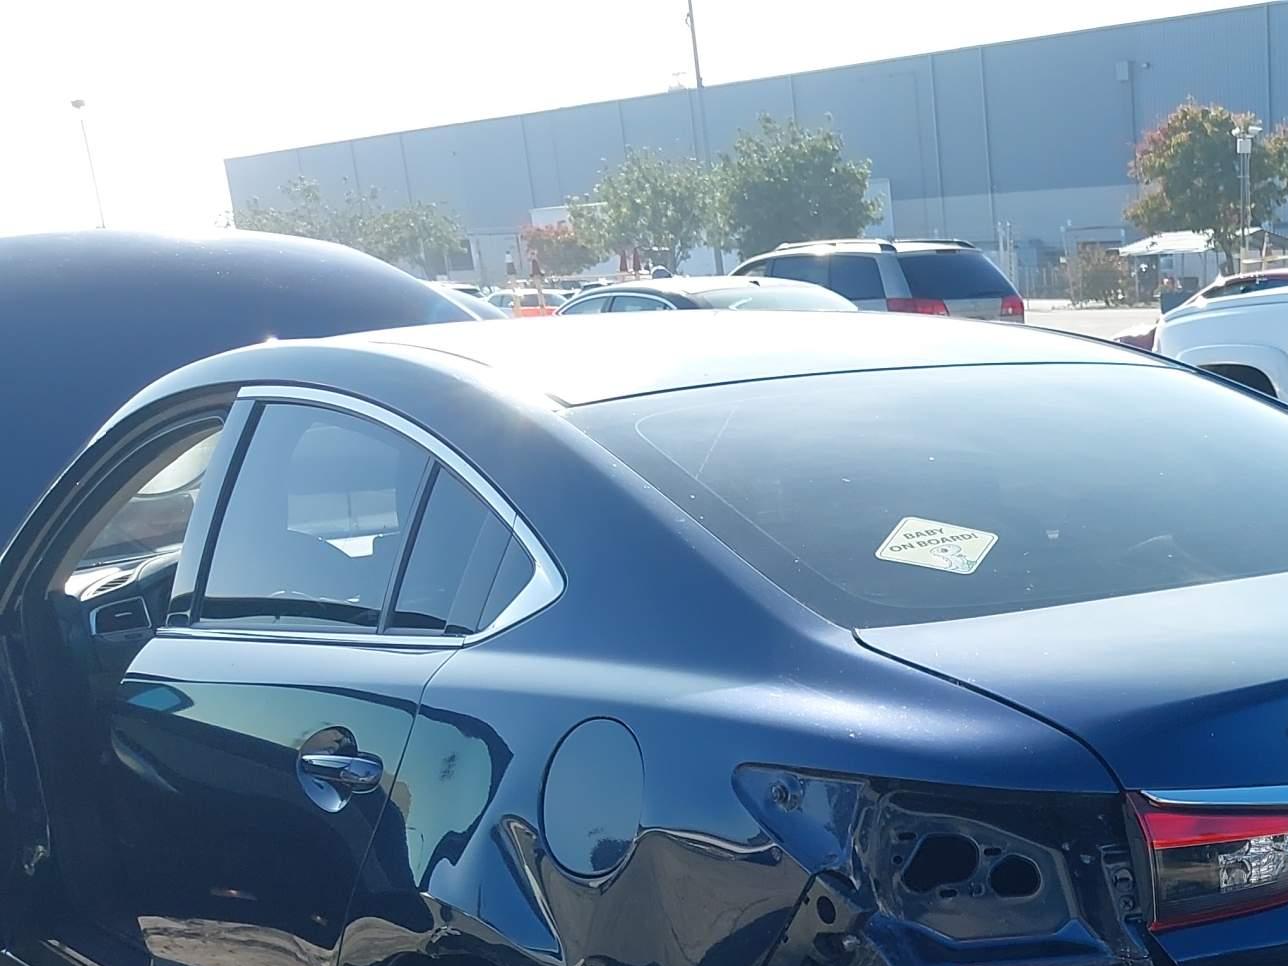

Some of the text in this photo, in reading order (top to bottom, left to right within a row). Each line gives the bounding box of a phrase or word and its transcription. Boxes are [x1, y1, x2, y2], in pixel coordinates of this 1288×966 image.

[903, 527, 945, 540] BABY
[888, 532, 979, 553] ON BOARD!
